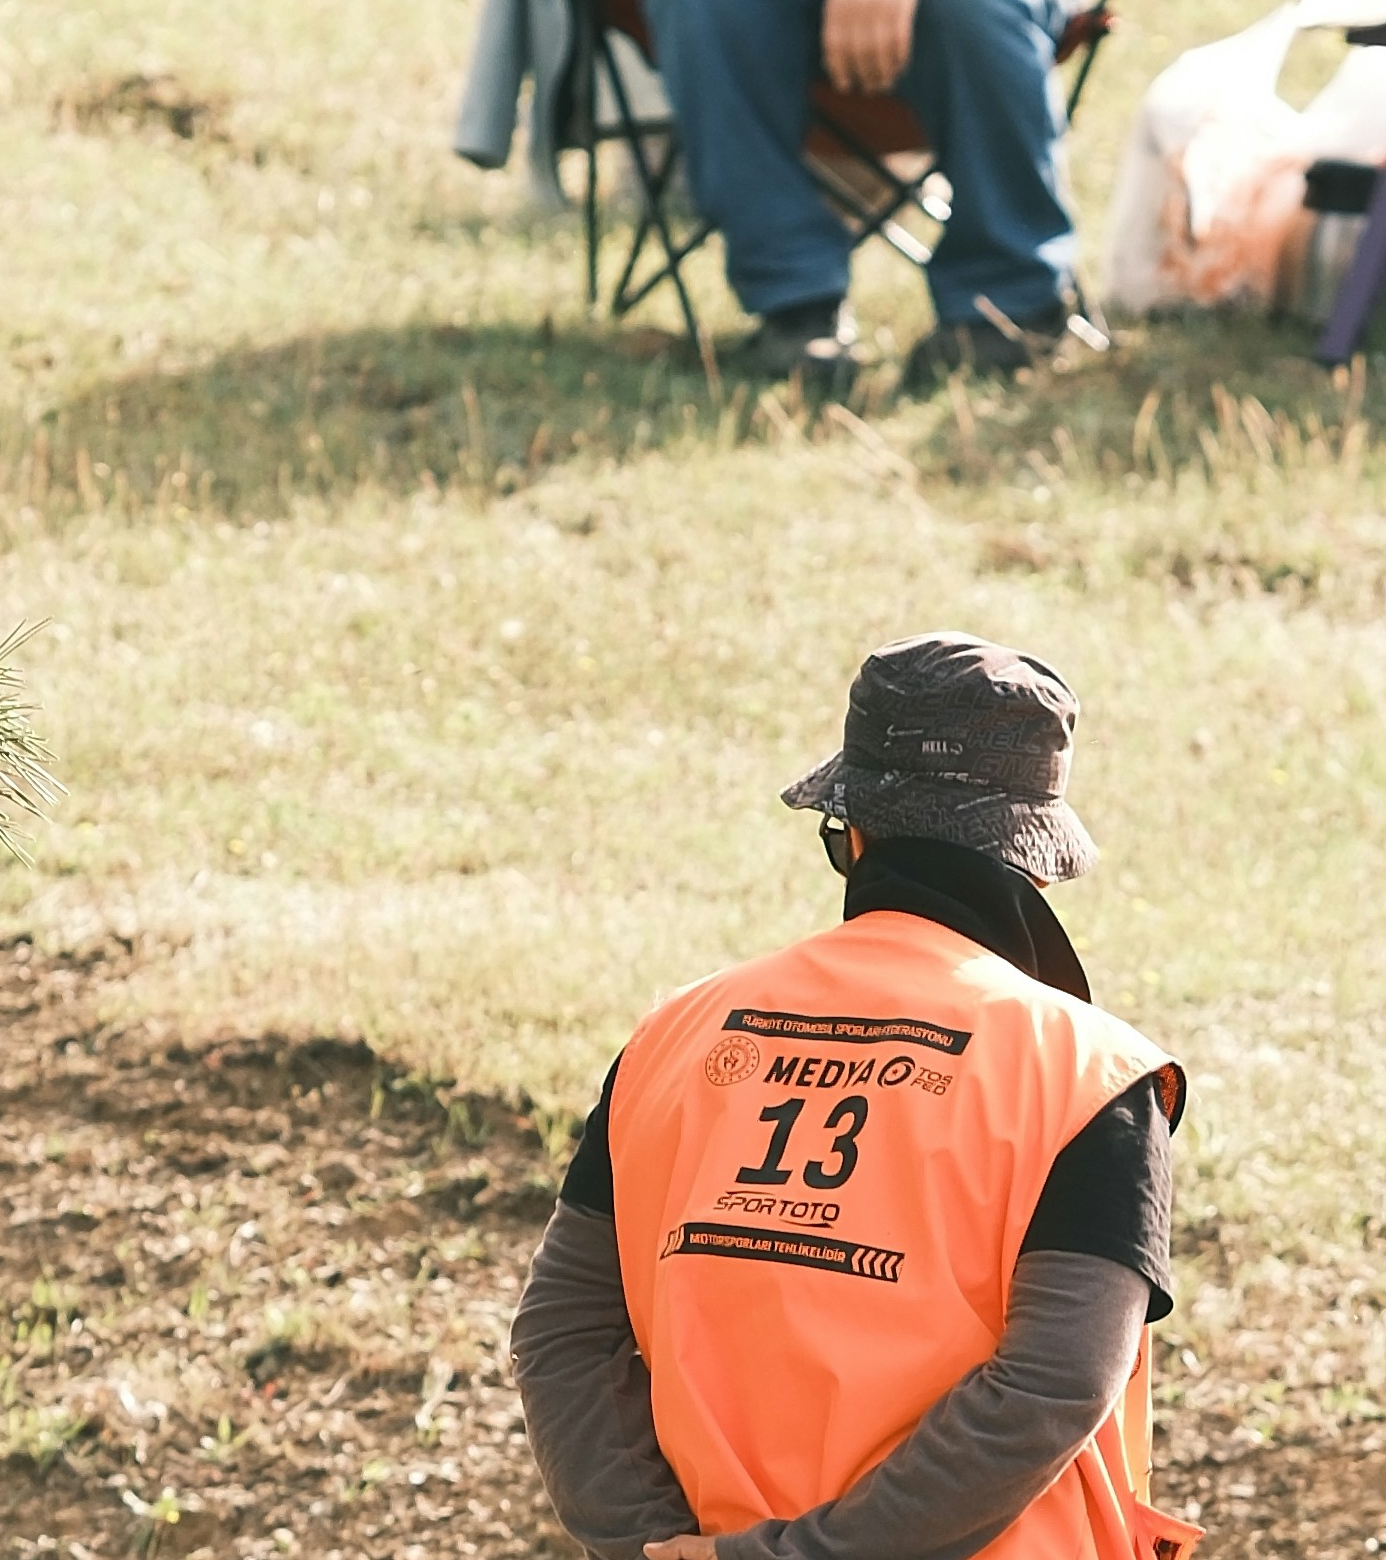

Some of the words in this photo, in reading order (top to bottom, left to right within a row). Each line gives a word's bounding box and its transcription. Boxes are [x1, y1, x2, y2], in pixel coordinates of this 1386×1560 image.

[763, 1056, 876, 1089] MEDYA
[918, 1067, 953, 1086] TOS
[910, 1079, 947, 1096] FED
[735, 1095, 869, 1189] 13
